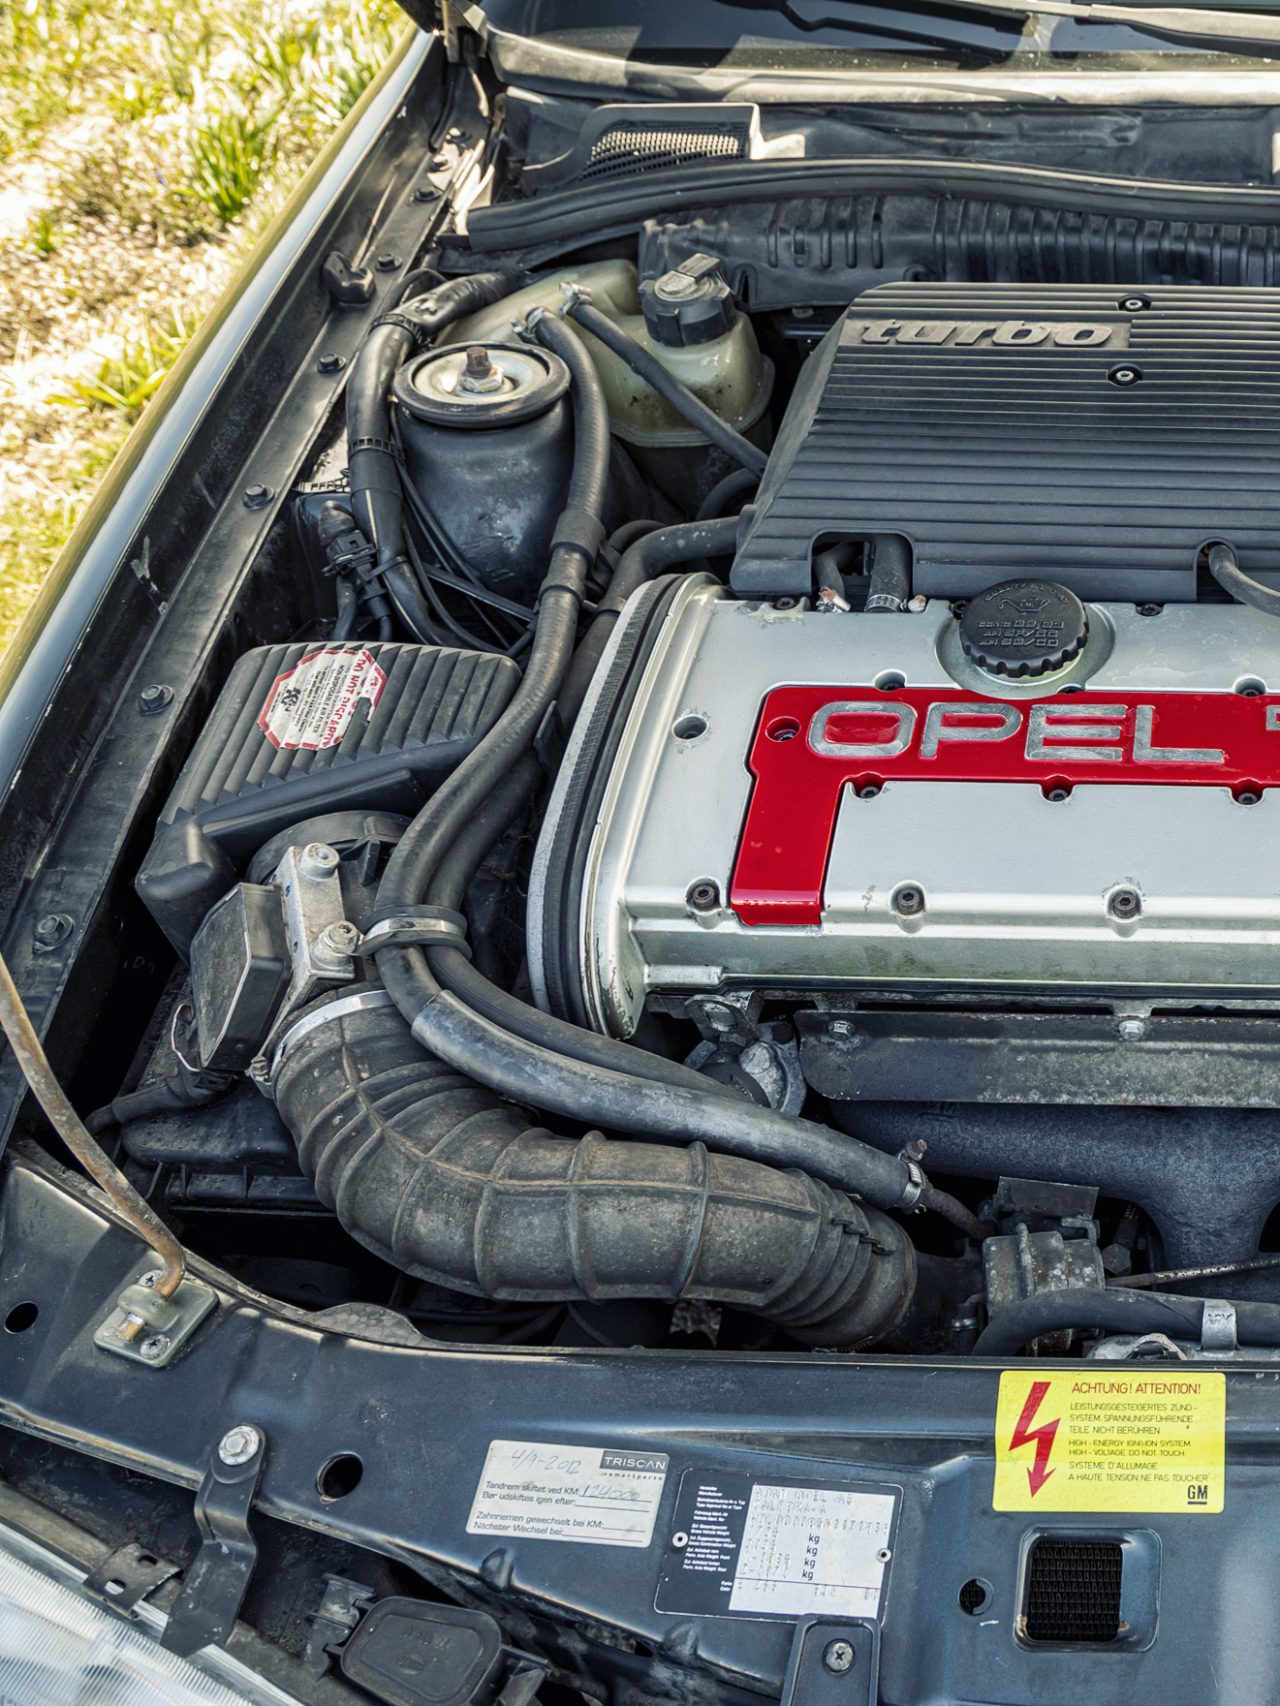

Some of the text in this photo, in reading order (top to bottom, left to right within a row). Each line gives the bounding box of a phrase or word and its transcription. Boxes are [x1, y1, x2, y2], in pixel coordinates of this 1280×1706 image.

[861, 318, 1113, 348] turbo
[808, 701, 1224, 763] OPEL
[1072, 1382, 1201, 1394] ACHTUNG! ATTENTION!
[1070, 1403, 1167, 1412] LEISTUNGSGESTEIGERTES
[1070, 1426, 1090, 1434] TEILE
[604, 1456, 666, 1470] TRISCAN
[486, 1480, 520, 1490] Tandrem
[522, 1482, 546, 1494] skiftet
[548, 1486, 562, 1494] ved
[1187, 1484, 1208, 1500] GM
[500, 1492, 534, 1502] udskiftes
[536, 1496, 552, 1505] igen
[476, 1510, 524, 1522] Zahnriemen
[526, 1516, 570, 1526] gewechselt
[572, 1518, 584, 1527] bei
[512, 1524, 548, 1534] Wechsel
[809, 1533, 820, 1544] kg
[806, 1546, 818, 1556] kg
[804, 1558, 816, 1569] kg
[802, 1570, 814, 1580] kg
